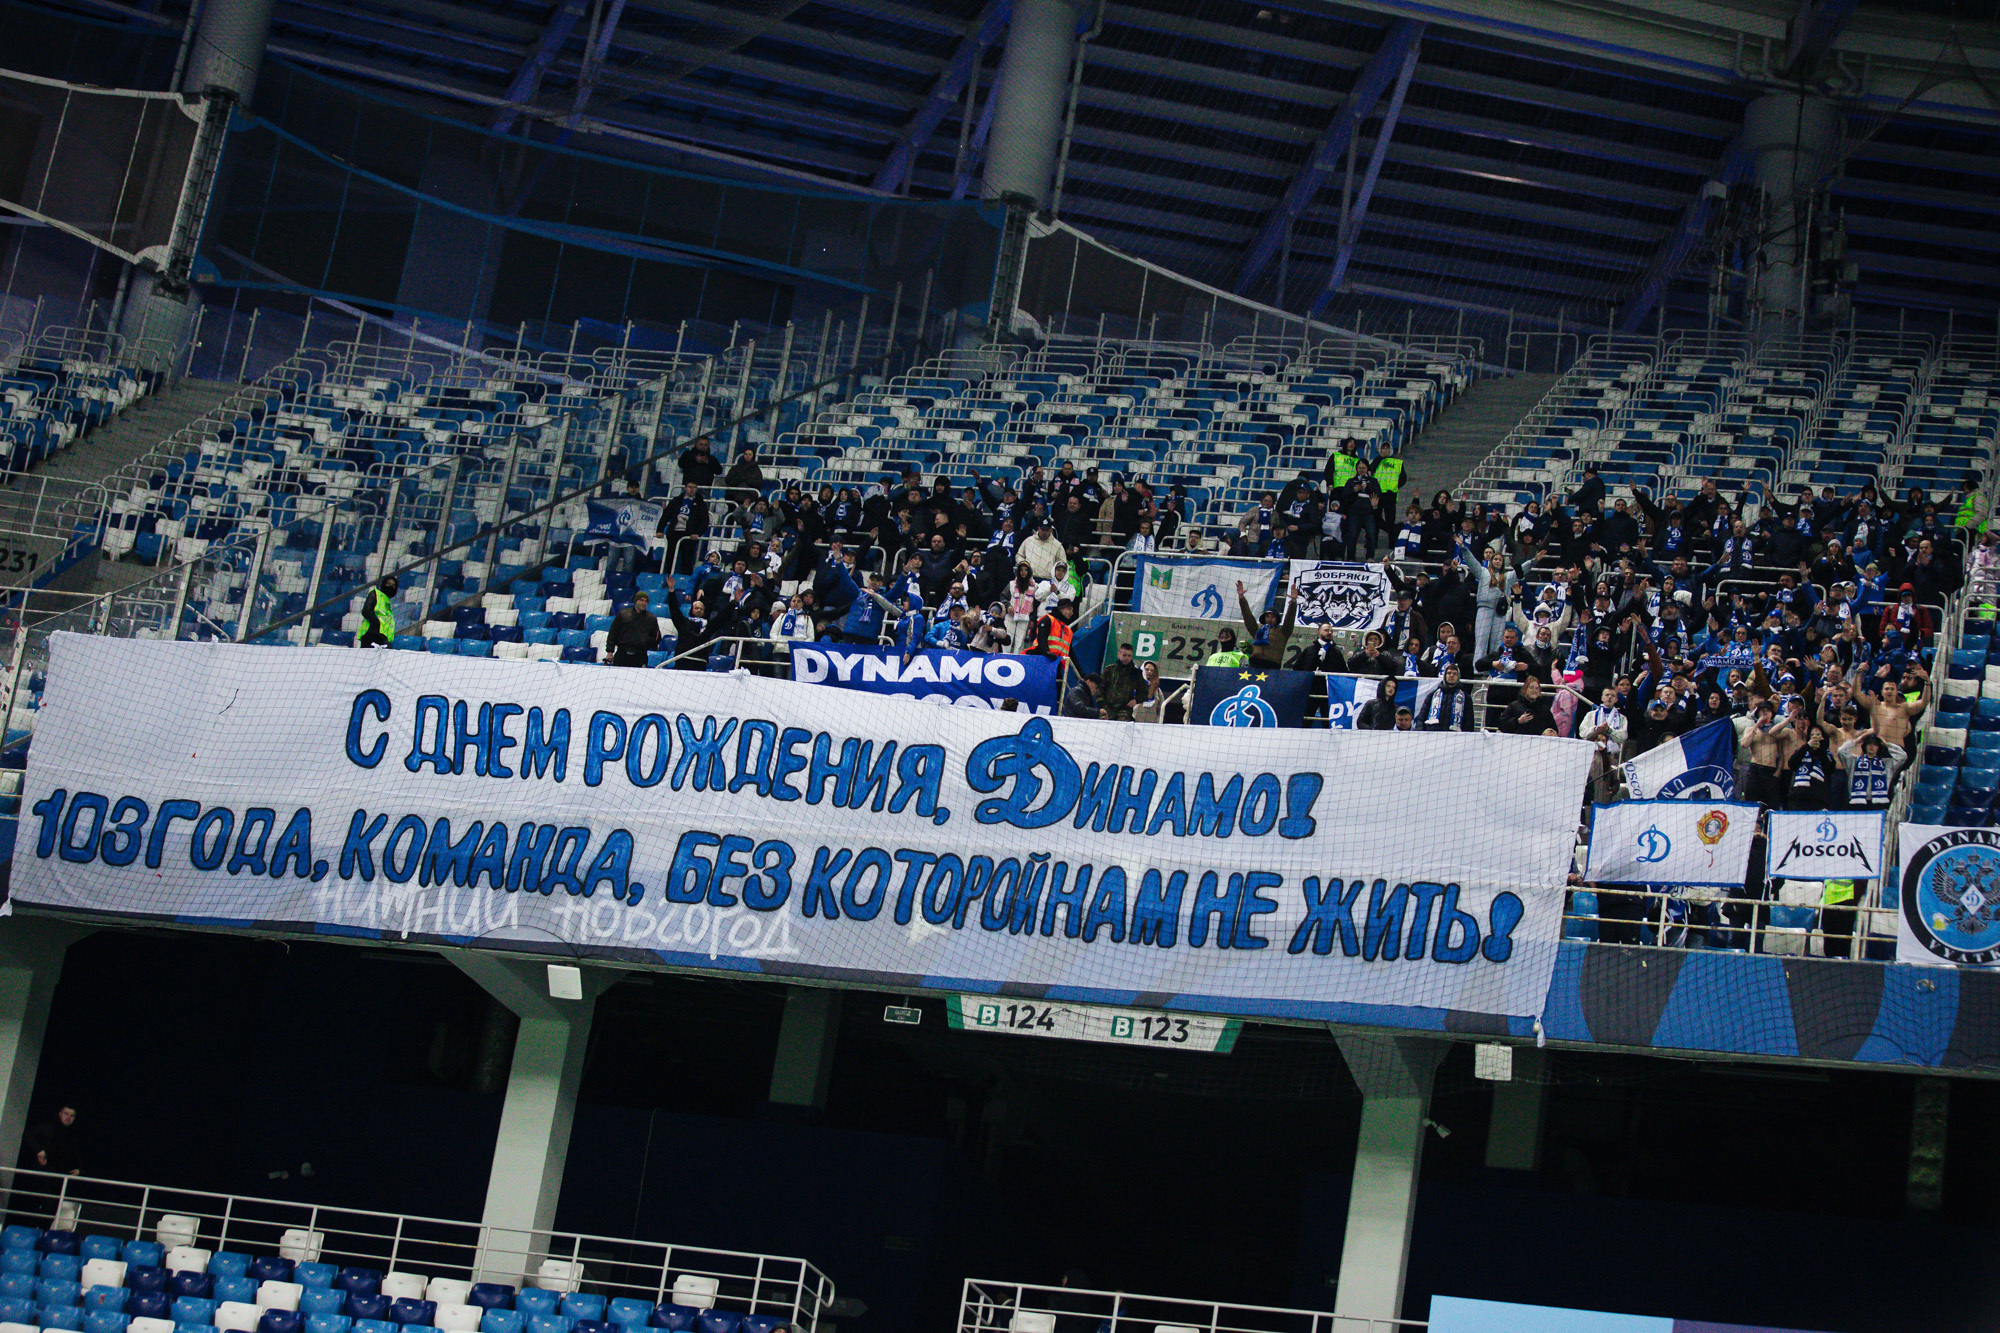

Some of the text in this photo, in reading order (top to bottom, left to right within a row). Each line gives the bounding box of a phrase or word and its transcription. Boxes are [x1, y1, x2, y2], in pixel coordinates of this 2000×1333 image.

[1314, 571, 1369, 582] ДОБРЯКИ
[1167, 636, 1219, 661] 231
[793, 648, 1026, 688] DYNAMO
[345, 688, 391, 769] С
[404, 694, 572, 783] ДНЕМ
[583, 709, 951, 826] РОЖДЕНИЯ,
[338, 808, 645, 907] КОМАНДА,
[665, 829, 797, 912] БЕЗ
[1188, 869, 1284, 950] НЕ
[1287, 875, 1525, 964] ЖИТЬ!
[1007, 1004, 1054, 1031] 124
[1141, 1016, 1190, 1043] 123
